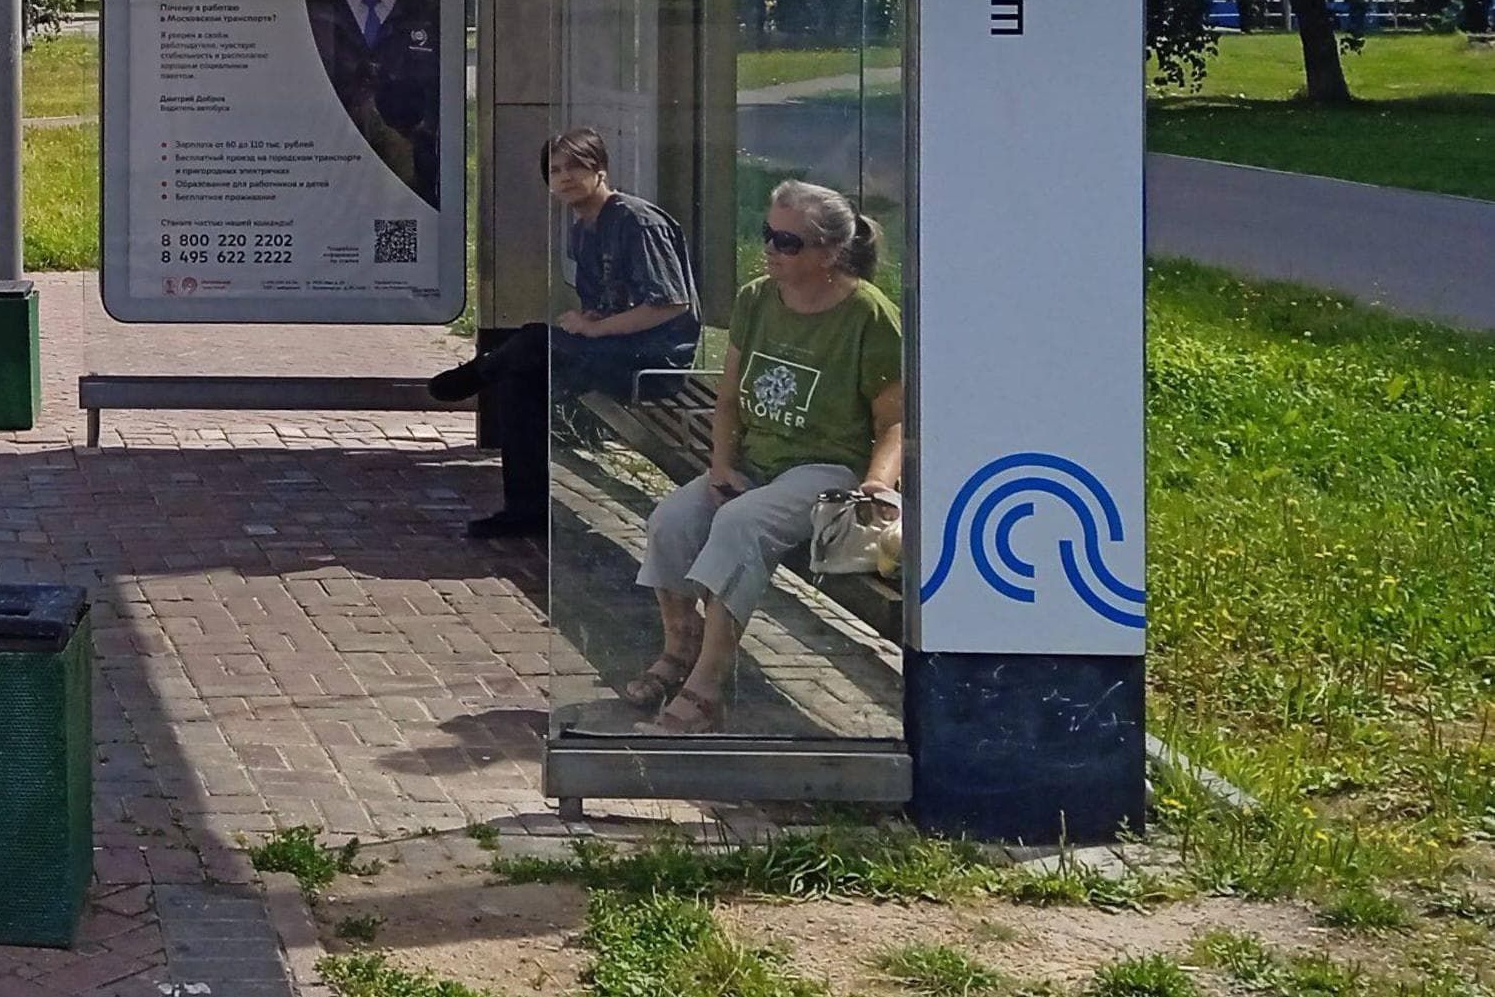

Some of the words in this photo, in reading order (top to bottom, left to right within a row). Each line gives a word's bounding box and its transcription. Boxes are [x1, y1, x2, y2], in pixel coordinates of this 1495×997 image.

[160, 3, 193, 12] Почему
[202, 4, 240, 12] работаю
[224, 14, 277, 22] транспорте?
[176, 141, 213, 149] Зарплата
[284, 140, 314, 149] рублей
[175, 180, 230, 188] Образование
[249, 180, 297, 188] работников
[175, 193, 223, 201] Бесплатное
[161, 234, 171, 247] 8
[179, 234, 210, 247] 800
[218, 234, 247, 247] 220
[255, 234, 293, 247] 2202
[161, 251, 171, 263] 8
[179, 251, 208, 263] 495
[217, 251, 246, 263] 622
[254, 251, 293, 263] 2222
[739, 396, 806, 428] FLOWER
